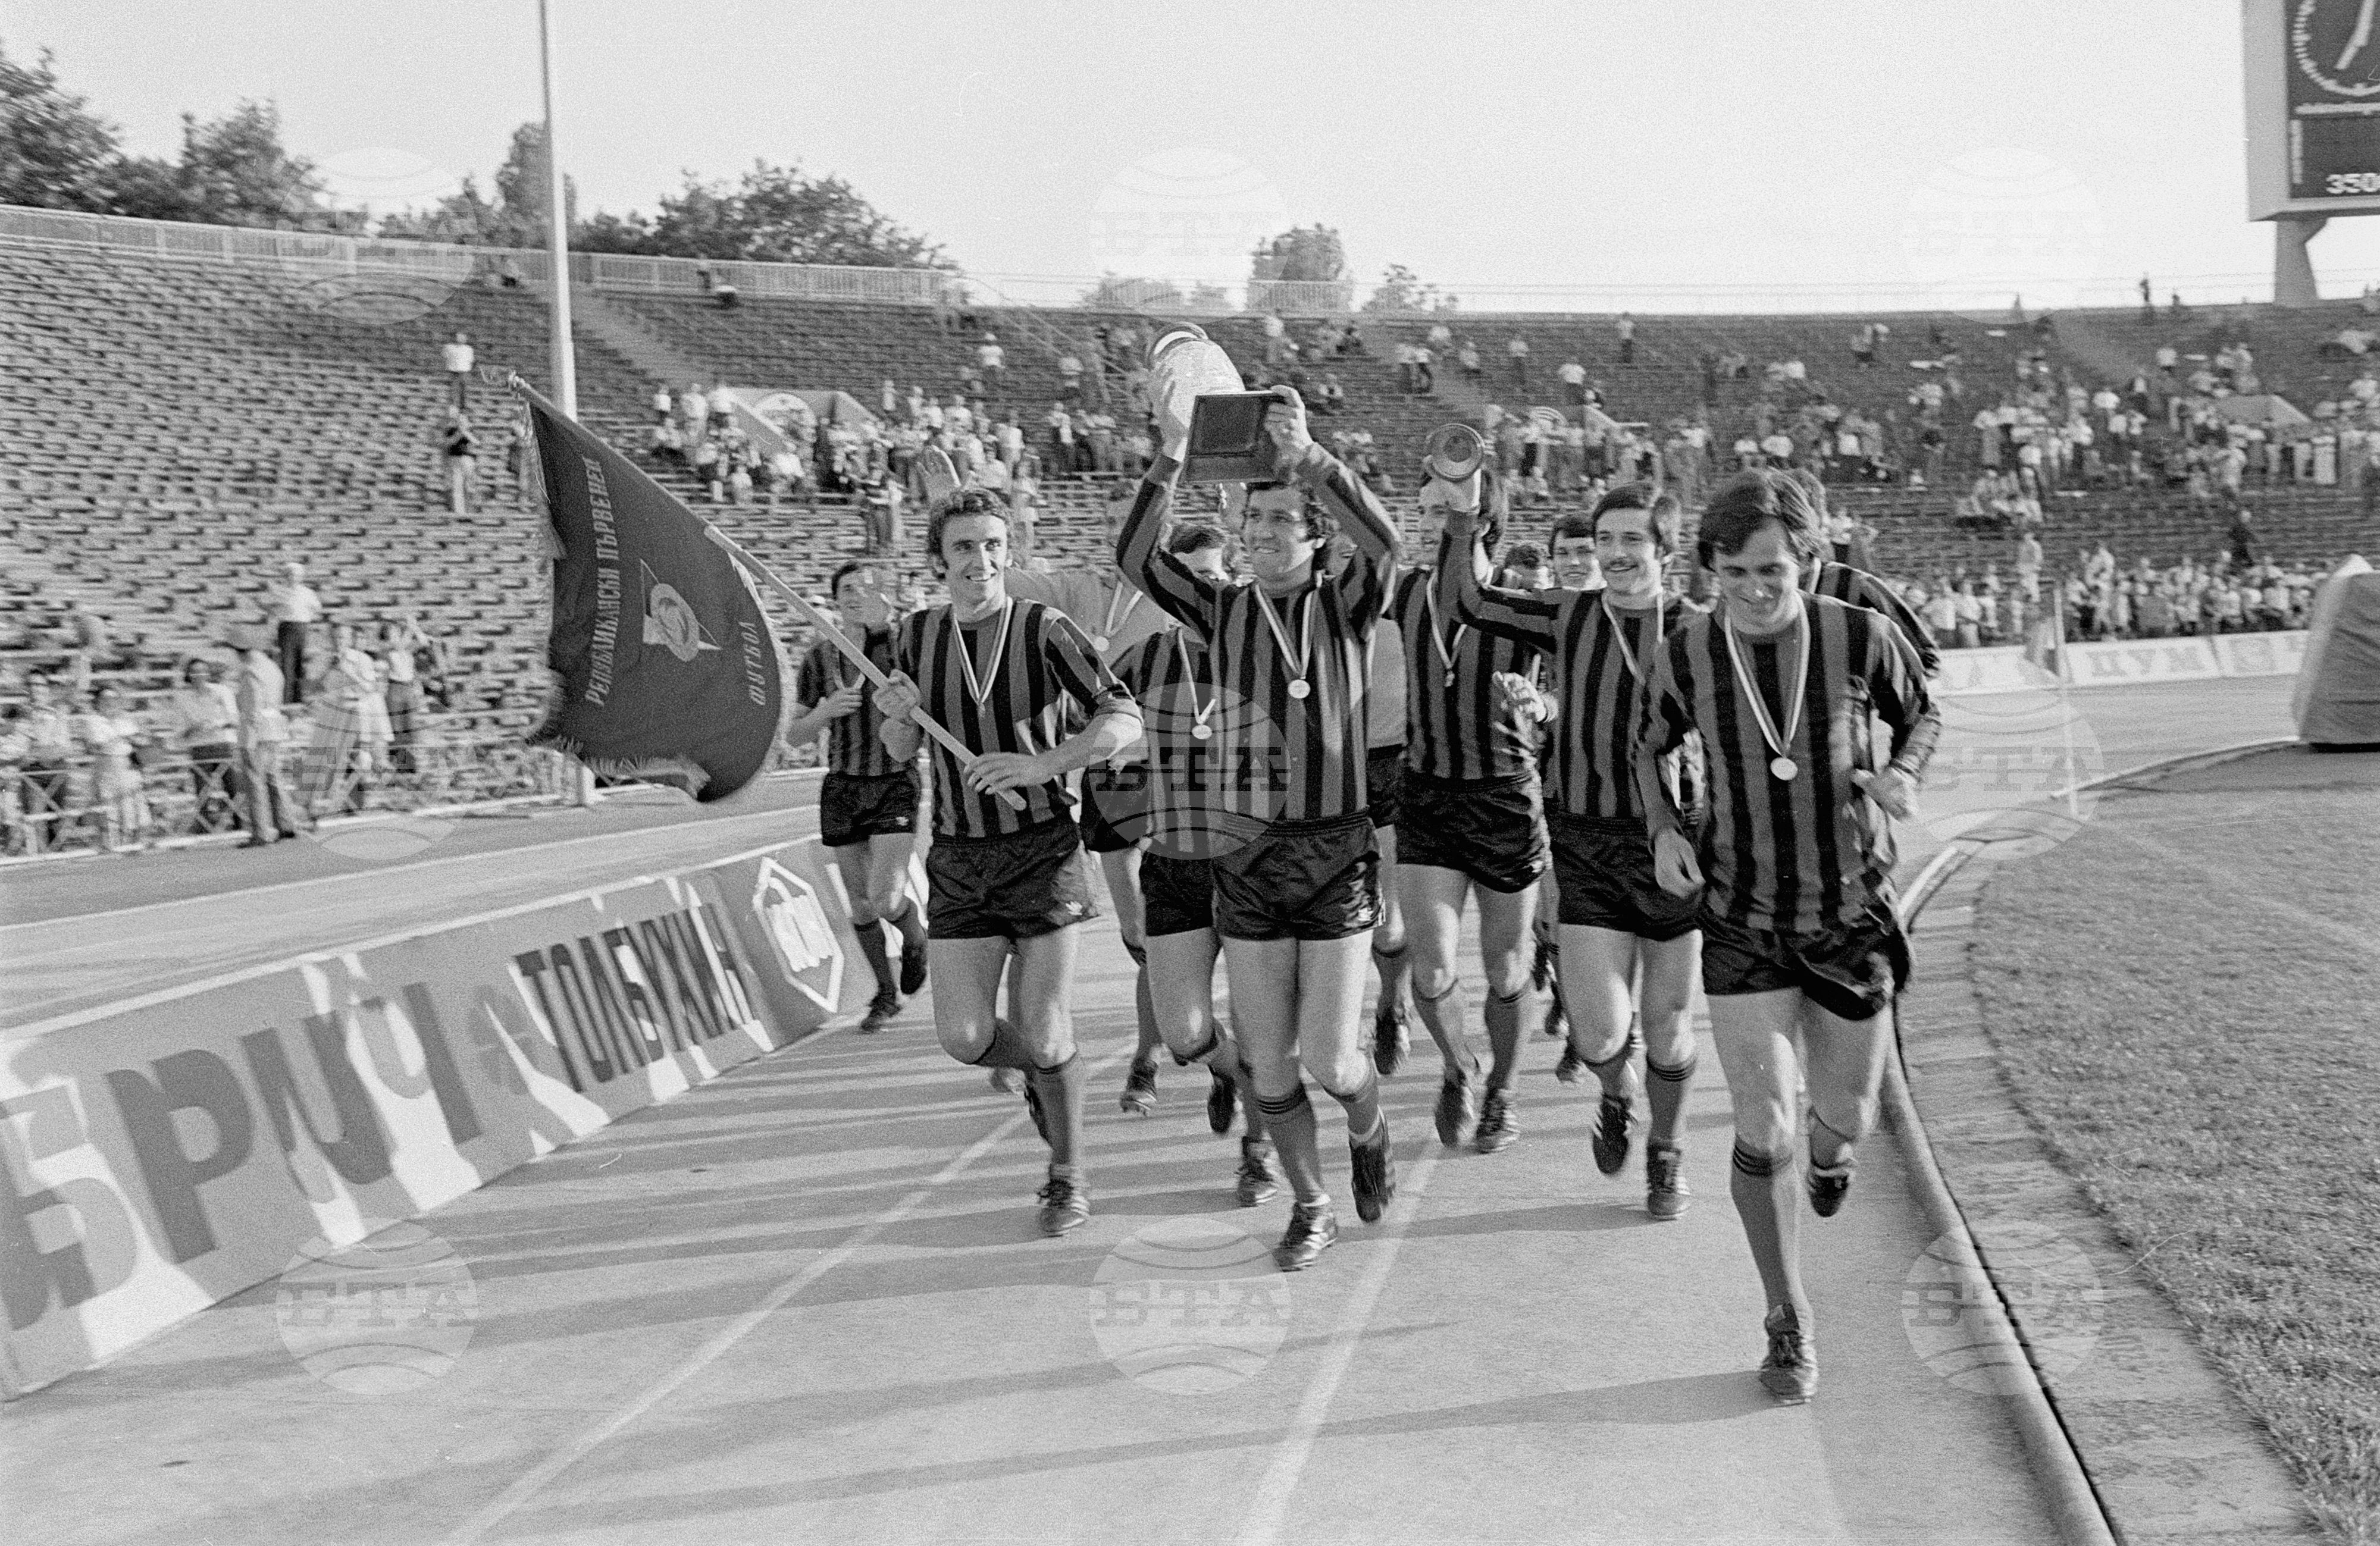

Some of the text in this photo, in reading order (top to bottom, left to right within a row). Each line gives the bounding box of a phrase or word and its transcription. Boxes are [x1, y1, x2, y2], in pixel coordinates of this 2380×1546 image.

[581, 454, 621, 706] РЕПУБЛИКАНСКИ ПЪРВЕНЕЦ
[738, 621, 766, 706] ФУТБОЛ
[512, 902, 757, 1093] ТОЛБУХИН
